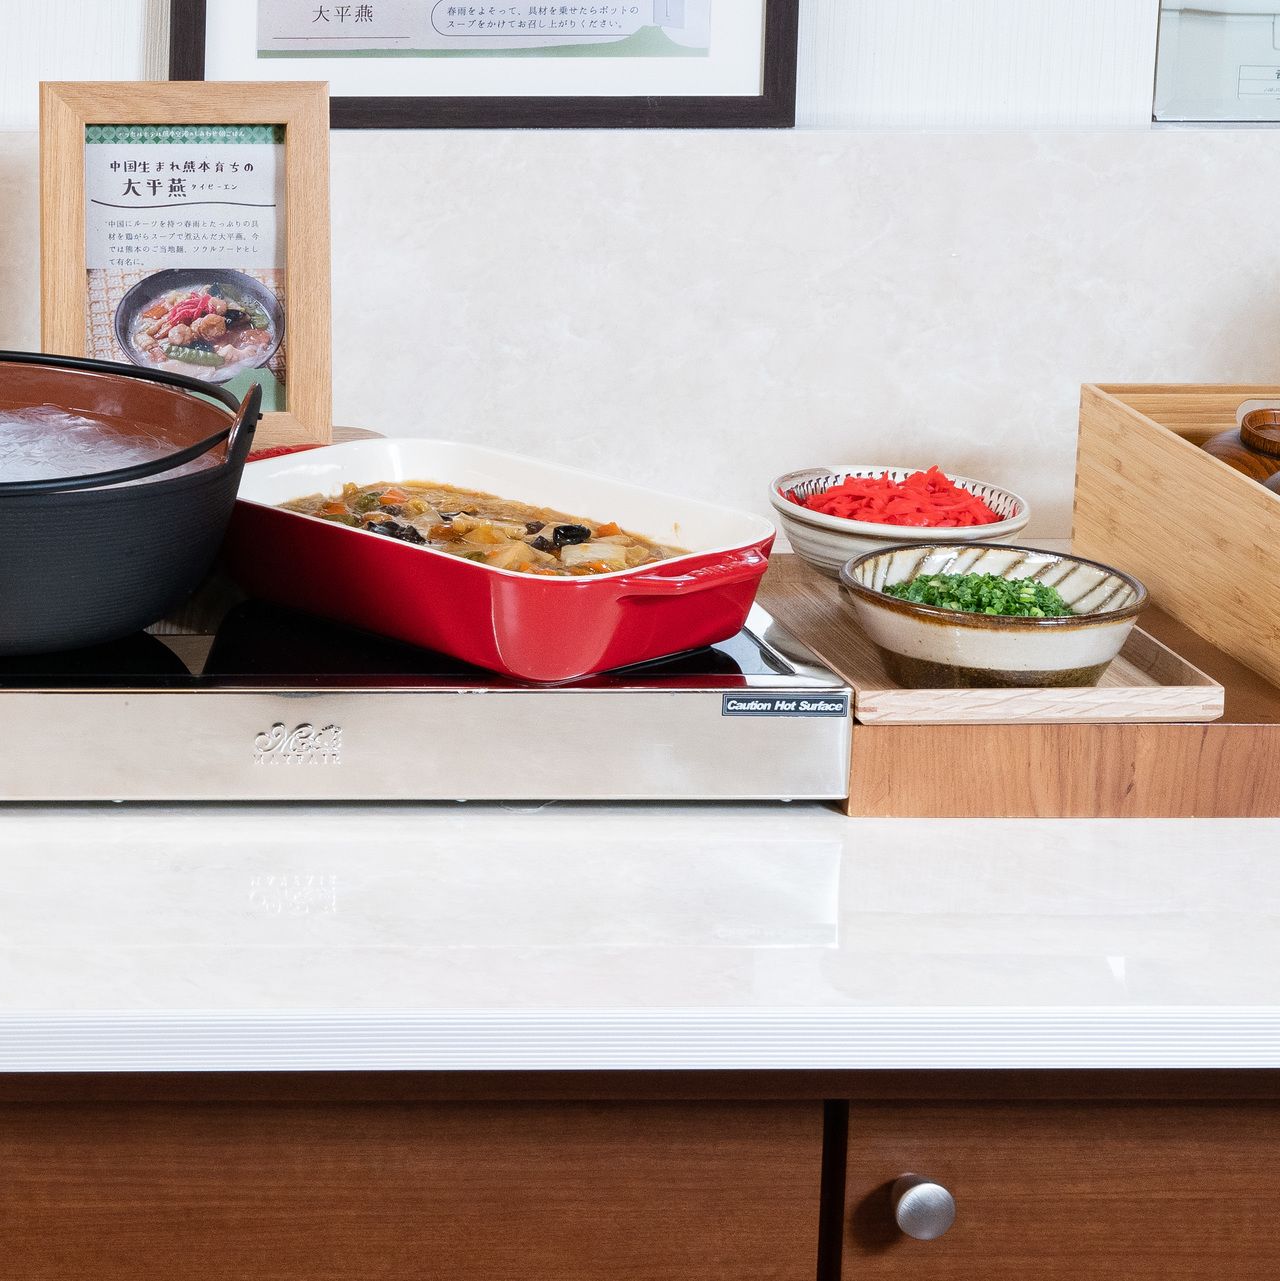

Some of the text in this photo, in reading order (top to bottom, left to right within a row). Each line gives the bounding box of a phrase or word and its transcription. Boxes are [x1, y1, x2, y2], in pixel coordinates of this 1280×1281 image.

[447, 19, 623, 29] スープをかけてお召し上がりください。
[110, 160, 254, 173] 中国生まれ熊本育ちの
[109, 258, 144, 266] て有名に。
[727, 700, 843, 711] Caution Hot Surface
